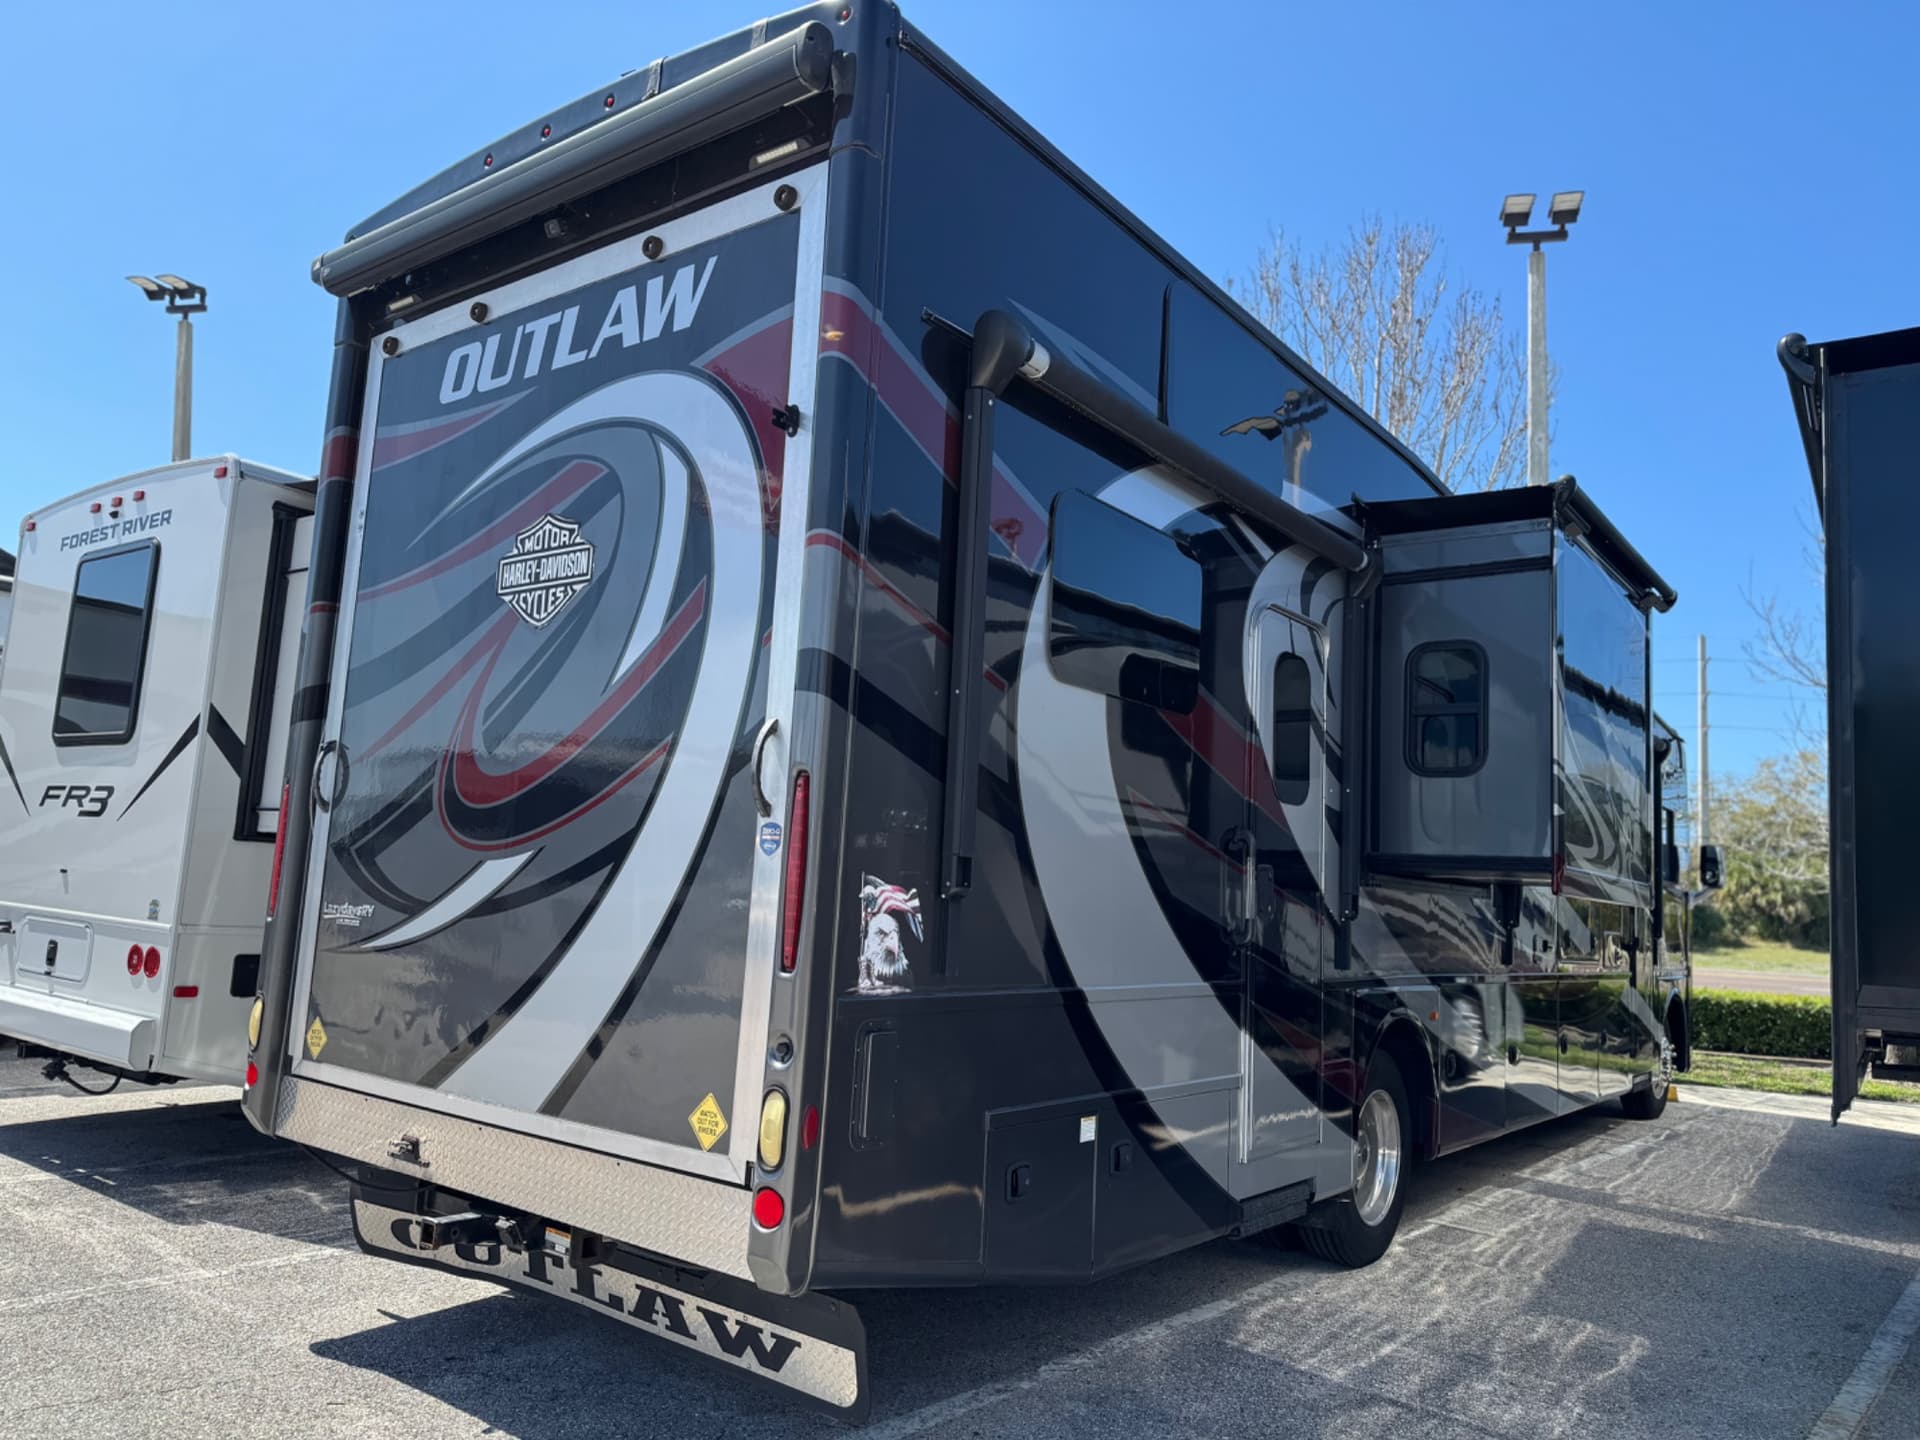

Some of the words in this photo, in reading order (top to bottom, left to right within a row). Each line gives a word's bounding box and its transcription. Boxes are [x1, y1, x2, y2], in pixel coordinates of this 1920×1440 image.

[439, 255, 718, 405] OUTLAW
[60, 522, 120, 552] FOREST
[121, 509, 173, 536] RIVER
[524, 523, 570, 553] MOTOR
[502, 549, 589, 588] HARLEY-DAVIDSON
[519, 586, 566, 620] CYCLES
[38, 785, 115, 817] FR3
